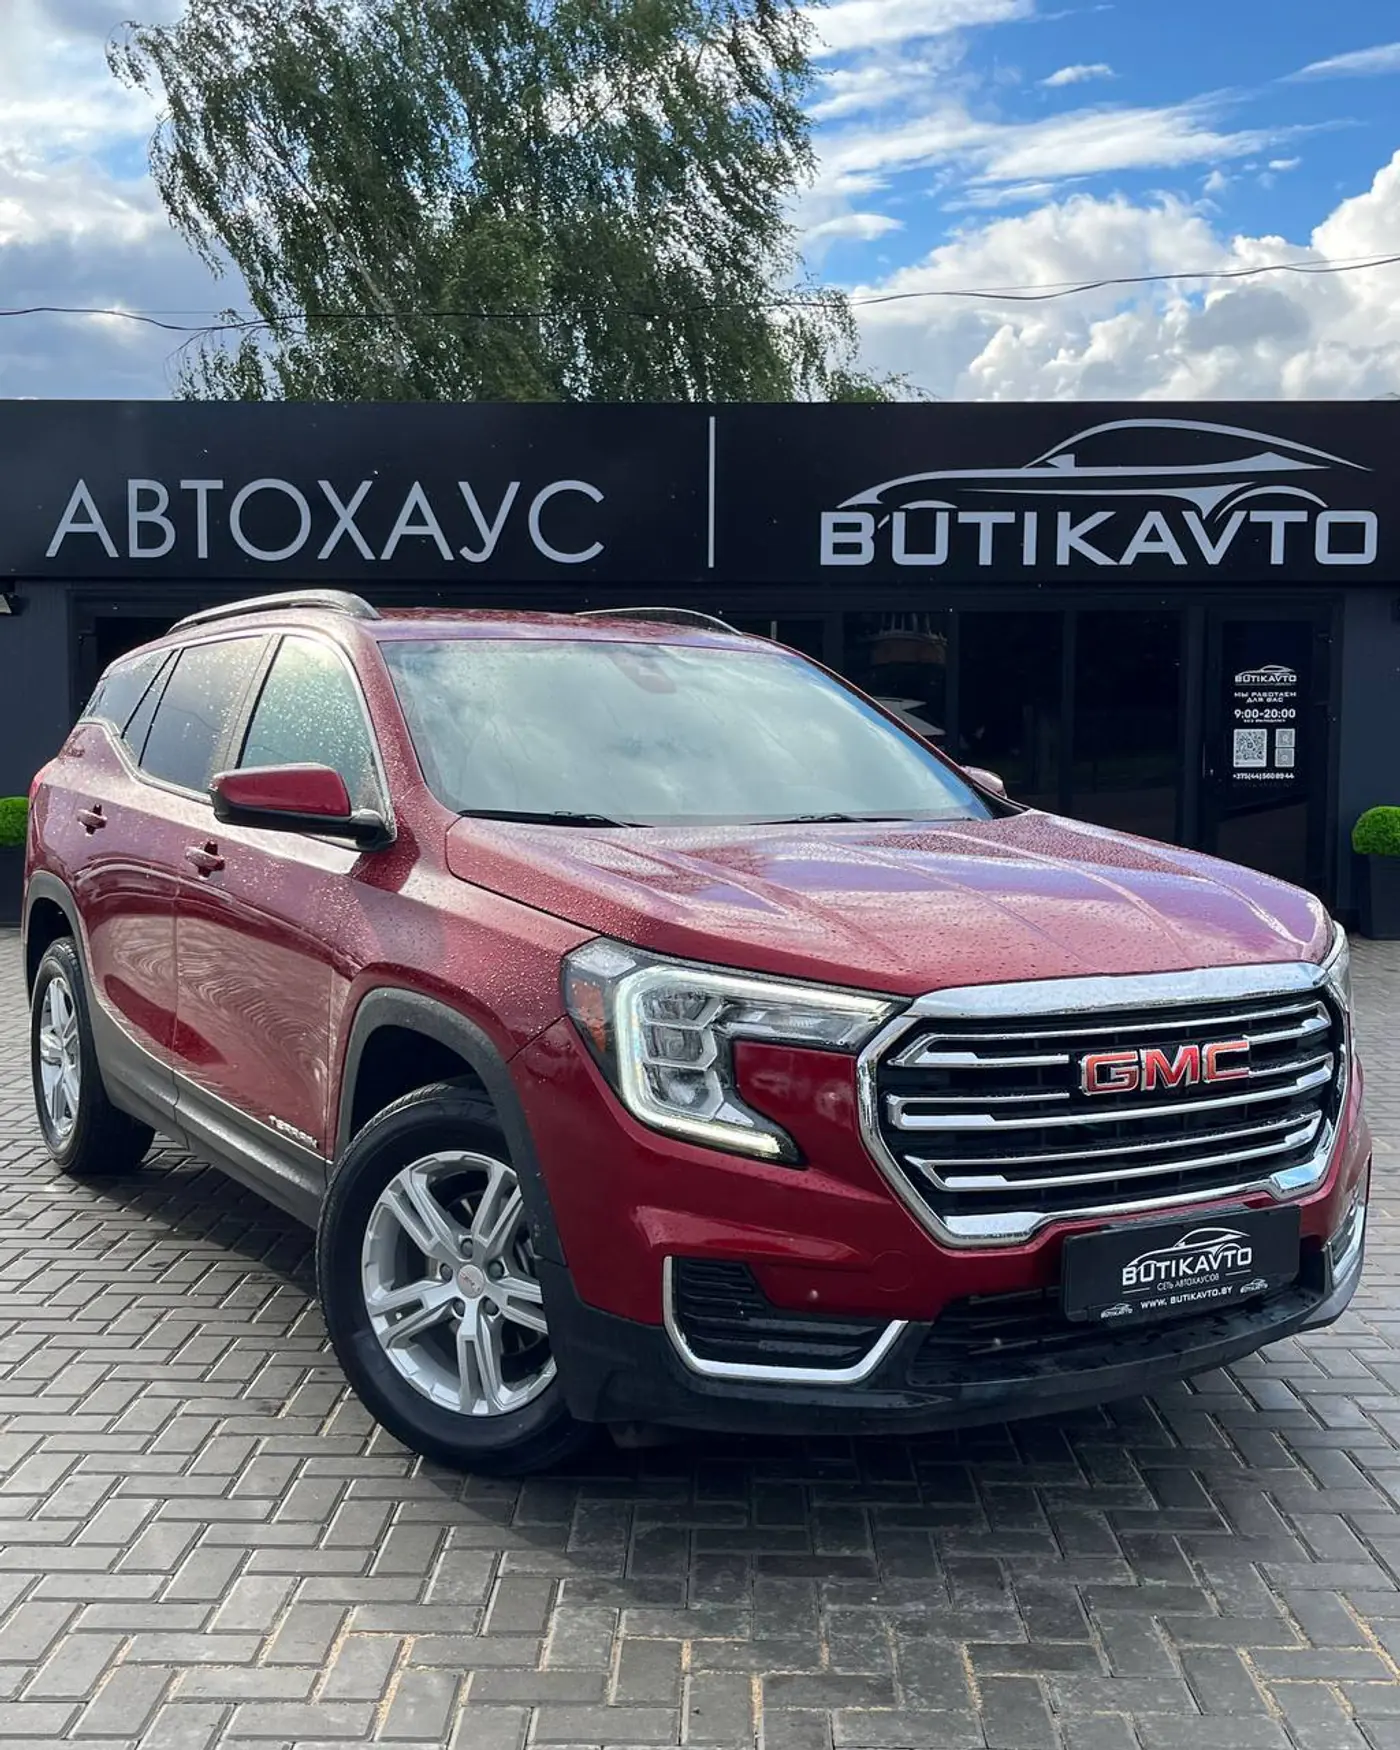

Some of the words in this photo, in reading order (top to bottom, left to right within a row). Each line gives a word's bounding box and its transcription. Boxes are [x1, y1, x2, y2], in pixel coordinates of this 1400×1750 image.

[45, 478, 605, 563] АВТОХАУС
[820, 510, 1378, 566] BUTIKAVTO
[1234, 674, 1297, 683] BUTIKAVTO
[1234, 708, 1296, 719] 9:00-20:00
[1081, 1040, 1250, 1096] GMC
[1122, 1247, 1253, 1287] BUTIKAVTO
